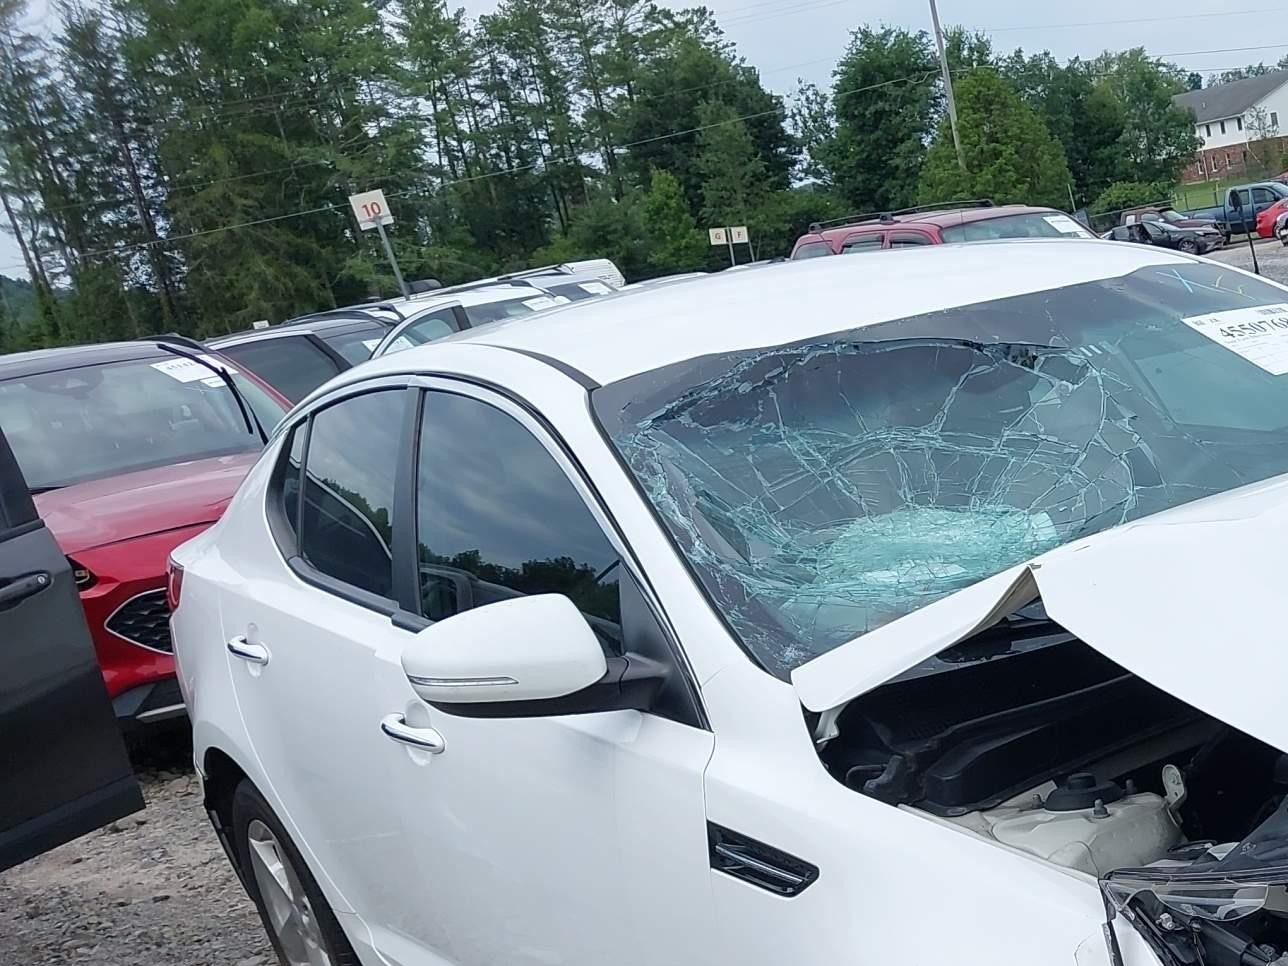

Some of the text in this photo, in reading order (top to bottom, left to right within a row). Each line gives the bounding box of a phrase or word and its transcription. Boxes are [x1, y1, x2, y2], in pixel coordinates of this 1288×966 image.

[361, 201, 382, 218] 10
[714, 232, 721, 240] G
[736, 231, 742, 239] F
